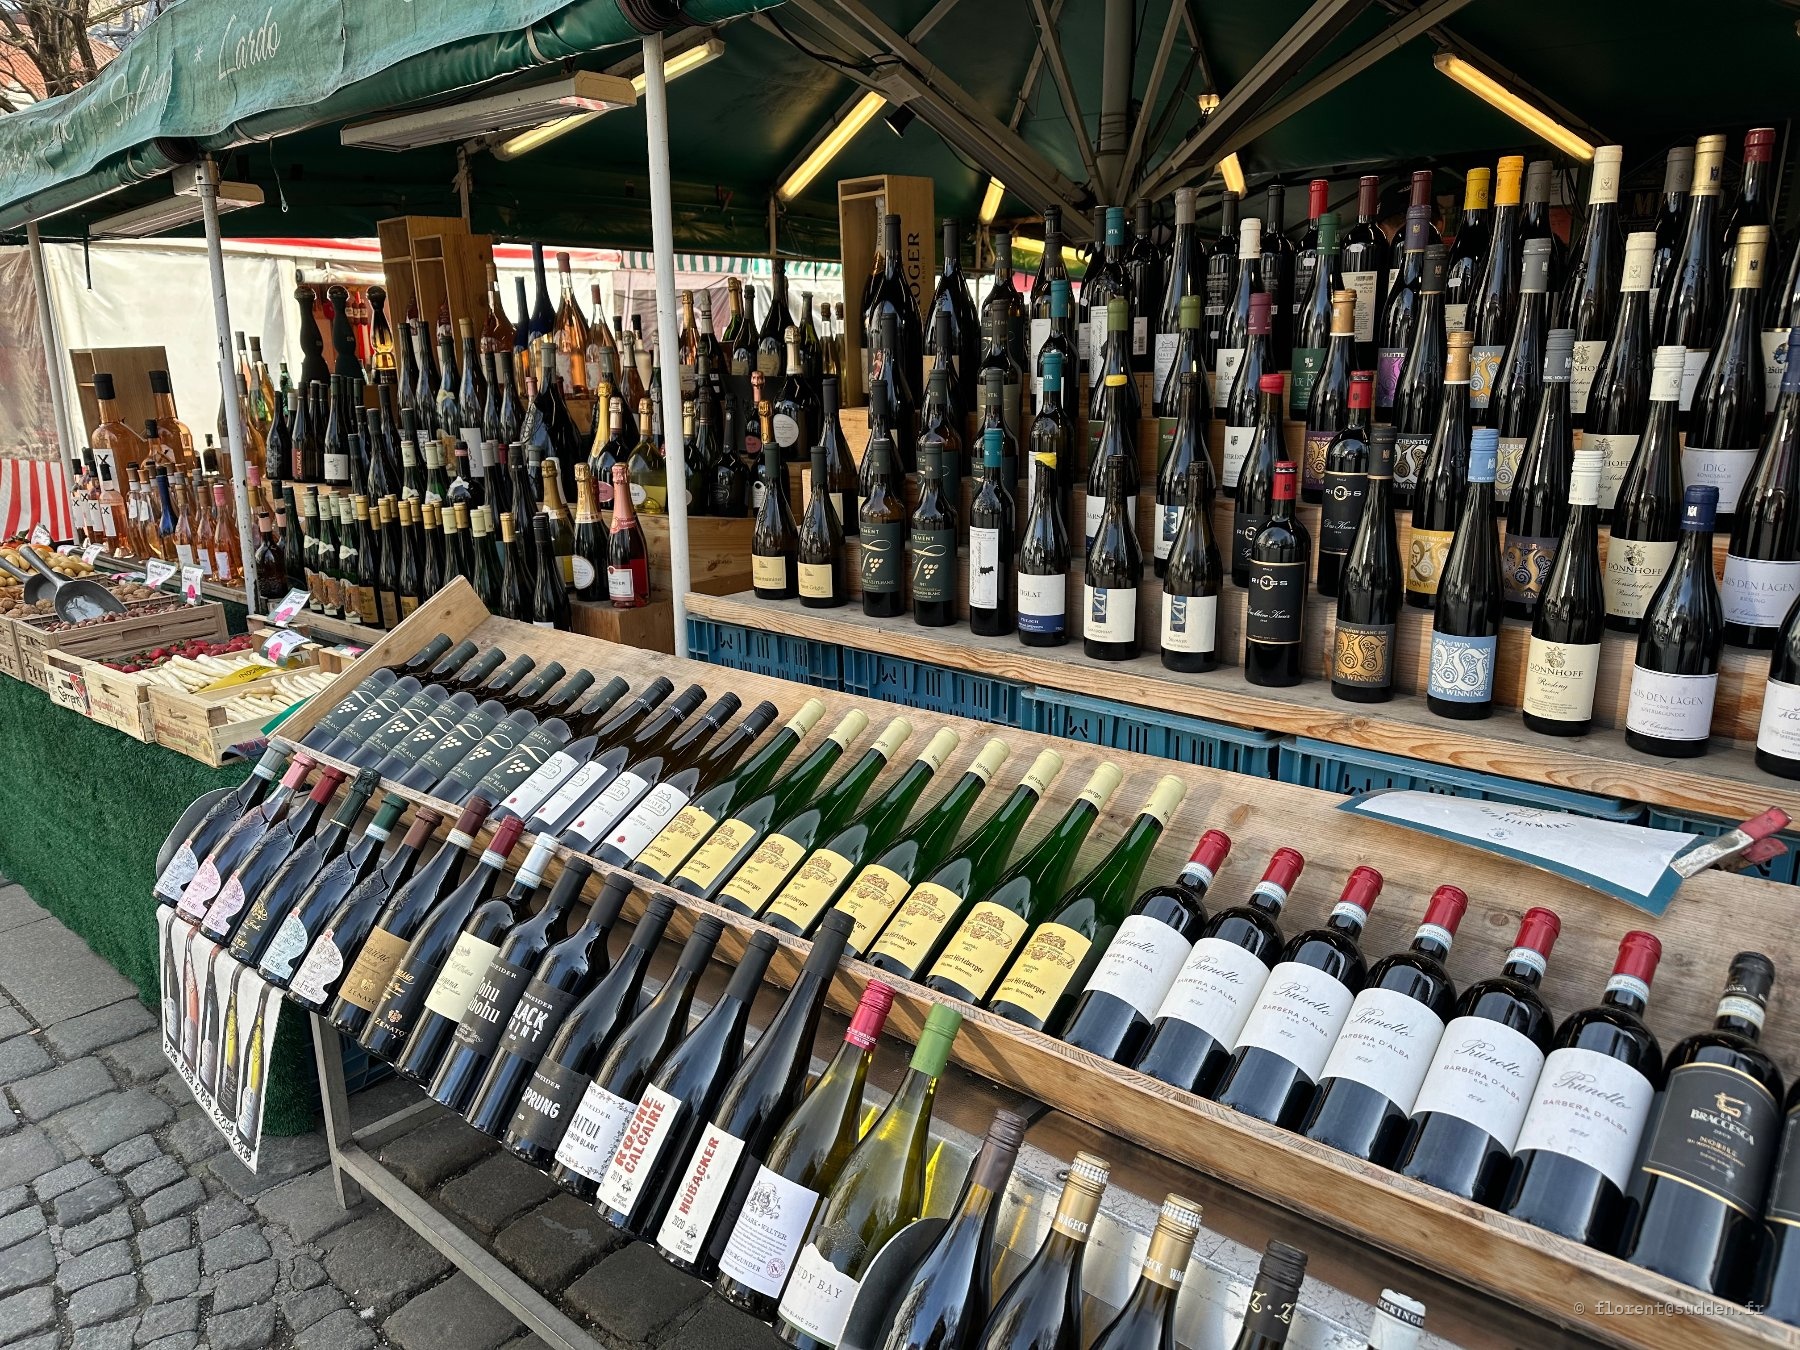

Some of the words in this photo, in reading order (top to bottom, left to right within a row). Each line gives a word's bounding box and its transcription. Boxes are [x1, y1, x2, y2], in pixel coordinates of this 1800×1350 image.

[217, 5, 282, 81] Lardo
[1108, 228, 1119, 236] STK
[907, 232, 921, 308] OGER
[1325, 486, 1362, 499] RINGS
[1251, 576, 1288, 589] RINGS
[1737, 579, 1758, 590] DEN
[1761, 582, 1795, 592] LAGEN
[1346, 674, 1383, 683] WINNING
[1537, 676, 1568, 691] Riesling
[1431, 686, 1445, 694] VON
[1445, 688, 1485, 697] WINNING
[1646, 692, 1669, 704] DEN
[1670, 695, 1704, 706] LAGEN
[953, 953, 985, 974] Hirtzberger
[1127, 955, 1154, 974] D'ALBA
[1187, 955, 1244, 986] Prunotto
[1014, 976, 1047, 996] Hirtzberger
[1210, 983, 1238, 1006] D'ALBA
[1273, 981, 1334, 1017] Prunotto
[374, 1016, 406, 1037] ZENATO
[1262, 1004, 1299, 1019] BARBERA
[1301, 1016, 1329, 1039] D'ALBA
[1349, 1006, 1415, 1039] Prunotto
[1340, 1033, 1375, 1047] BARBERA
[1378, 1039, 1410, 1060] D'ALBA
[1453, 1039, 1525, 1079] Prunotto
[1443, 1064, 1488, 1081] BARBERA
[1491, 1077, 1520, 1103] D'ALBA
[1552, 1070, 1632, 1111] Prunotto
[1542, 1098, 1590, 1114] BARBERA
[1593, 1108, 1629, 1136] D'ALBA
[1690, 1108, 1755, 1146] BRACCESCA
[579, 1135, 599, 1154] BLANC
[624, 1099, 666, 1175] CALCAIRE
[678, 1135, 720, 1217] HUBACKER
[671, 1214, 686, 1231] 2020
[760, 1222, 788, 1242] WALTER
[1057, 1213, 1089, 1234] WAGECK
[816, 1278, 844, 1300] BAY
[789, 1309, 805, 1324] BLANC
